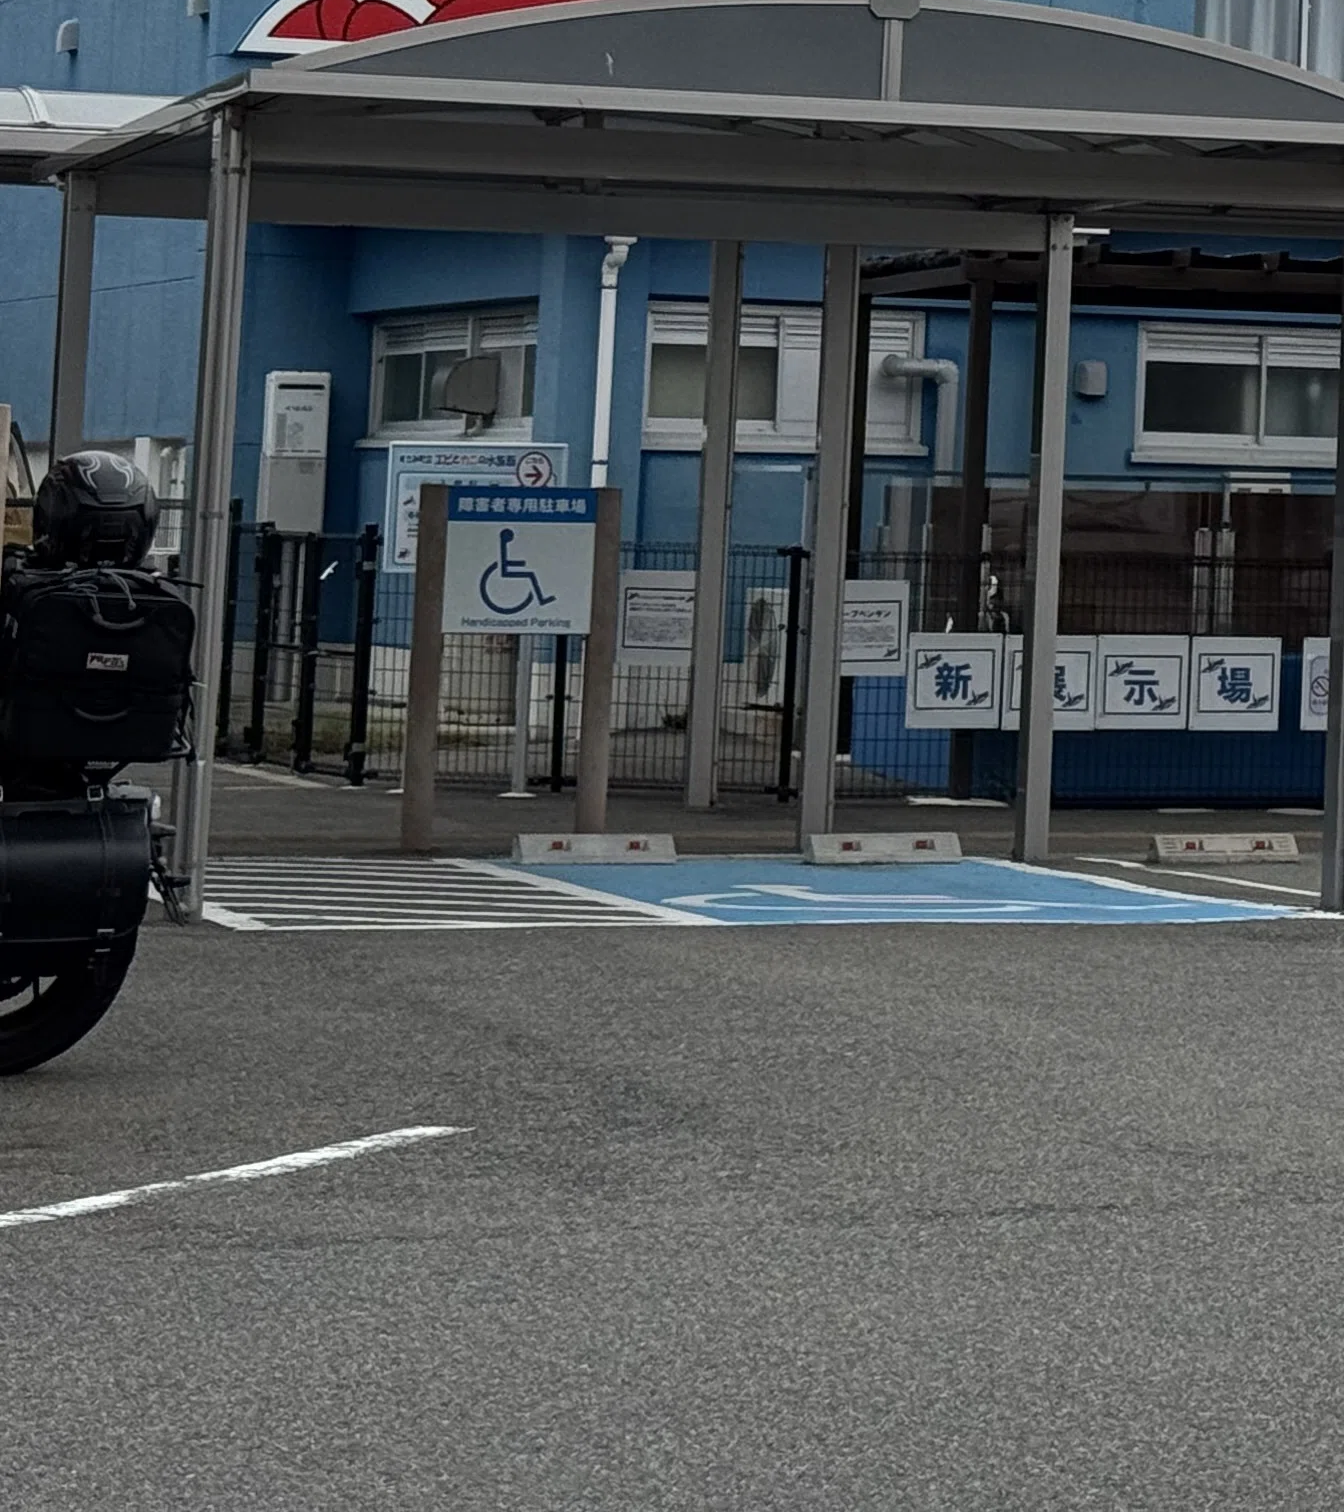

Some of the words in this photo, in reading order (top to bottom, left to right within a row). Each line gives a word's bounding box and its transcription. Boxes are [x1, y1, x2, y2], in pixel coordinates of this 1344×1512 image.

[458, 497, 587, 514] 障害者専用駐車場
[461, 617, 528, 628] Handicapped
[531, 617, 571, 629] Parking
